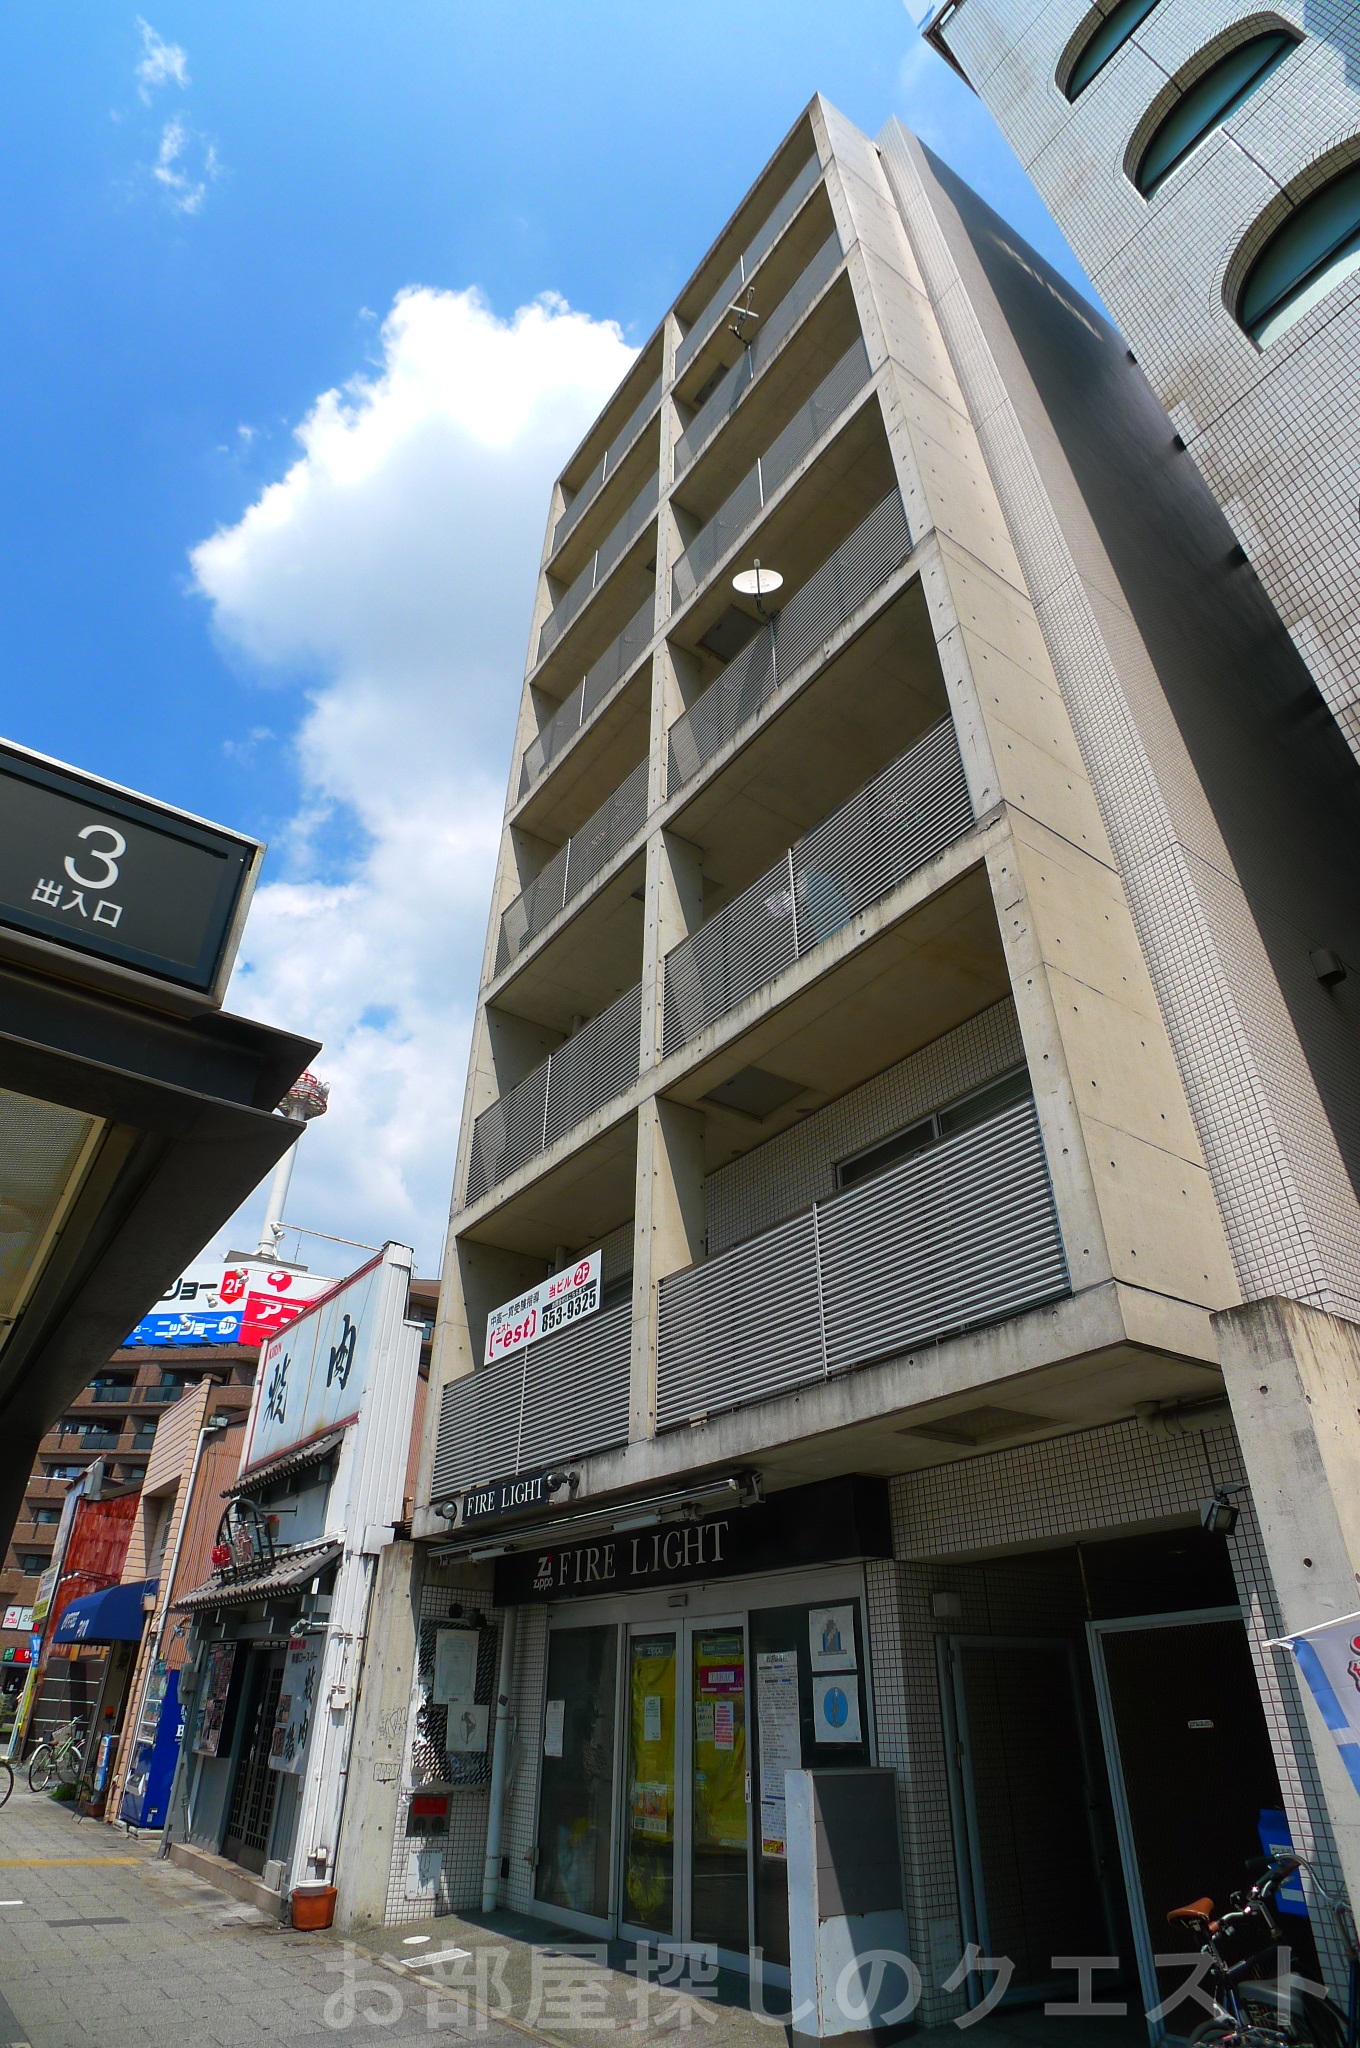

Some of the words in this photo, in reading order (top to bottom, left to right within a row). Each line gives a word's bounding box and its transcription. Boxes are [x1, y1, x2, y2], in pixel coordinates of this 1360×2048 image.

[64, 824, 127, 890] 3
[31, 878, 124, 928] 出入口
[541, 1288, 597, 1333] 853-9325
[549, 1275, 572, 1299] 当ビル
[466, 1491, 495, 1517] FIRE
[500, 1477, 544, 1508] LIGHT
[558, 1544, 616, 1586] FIRE
[630, 1521, 729, 1576] LIGHT
